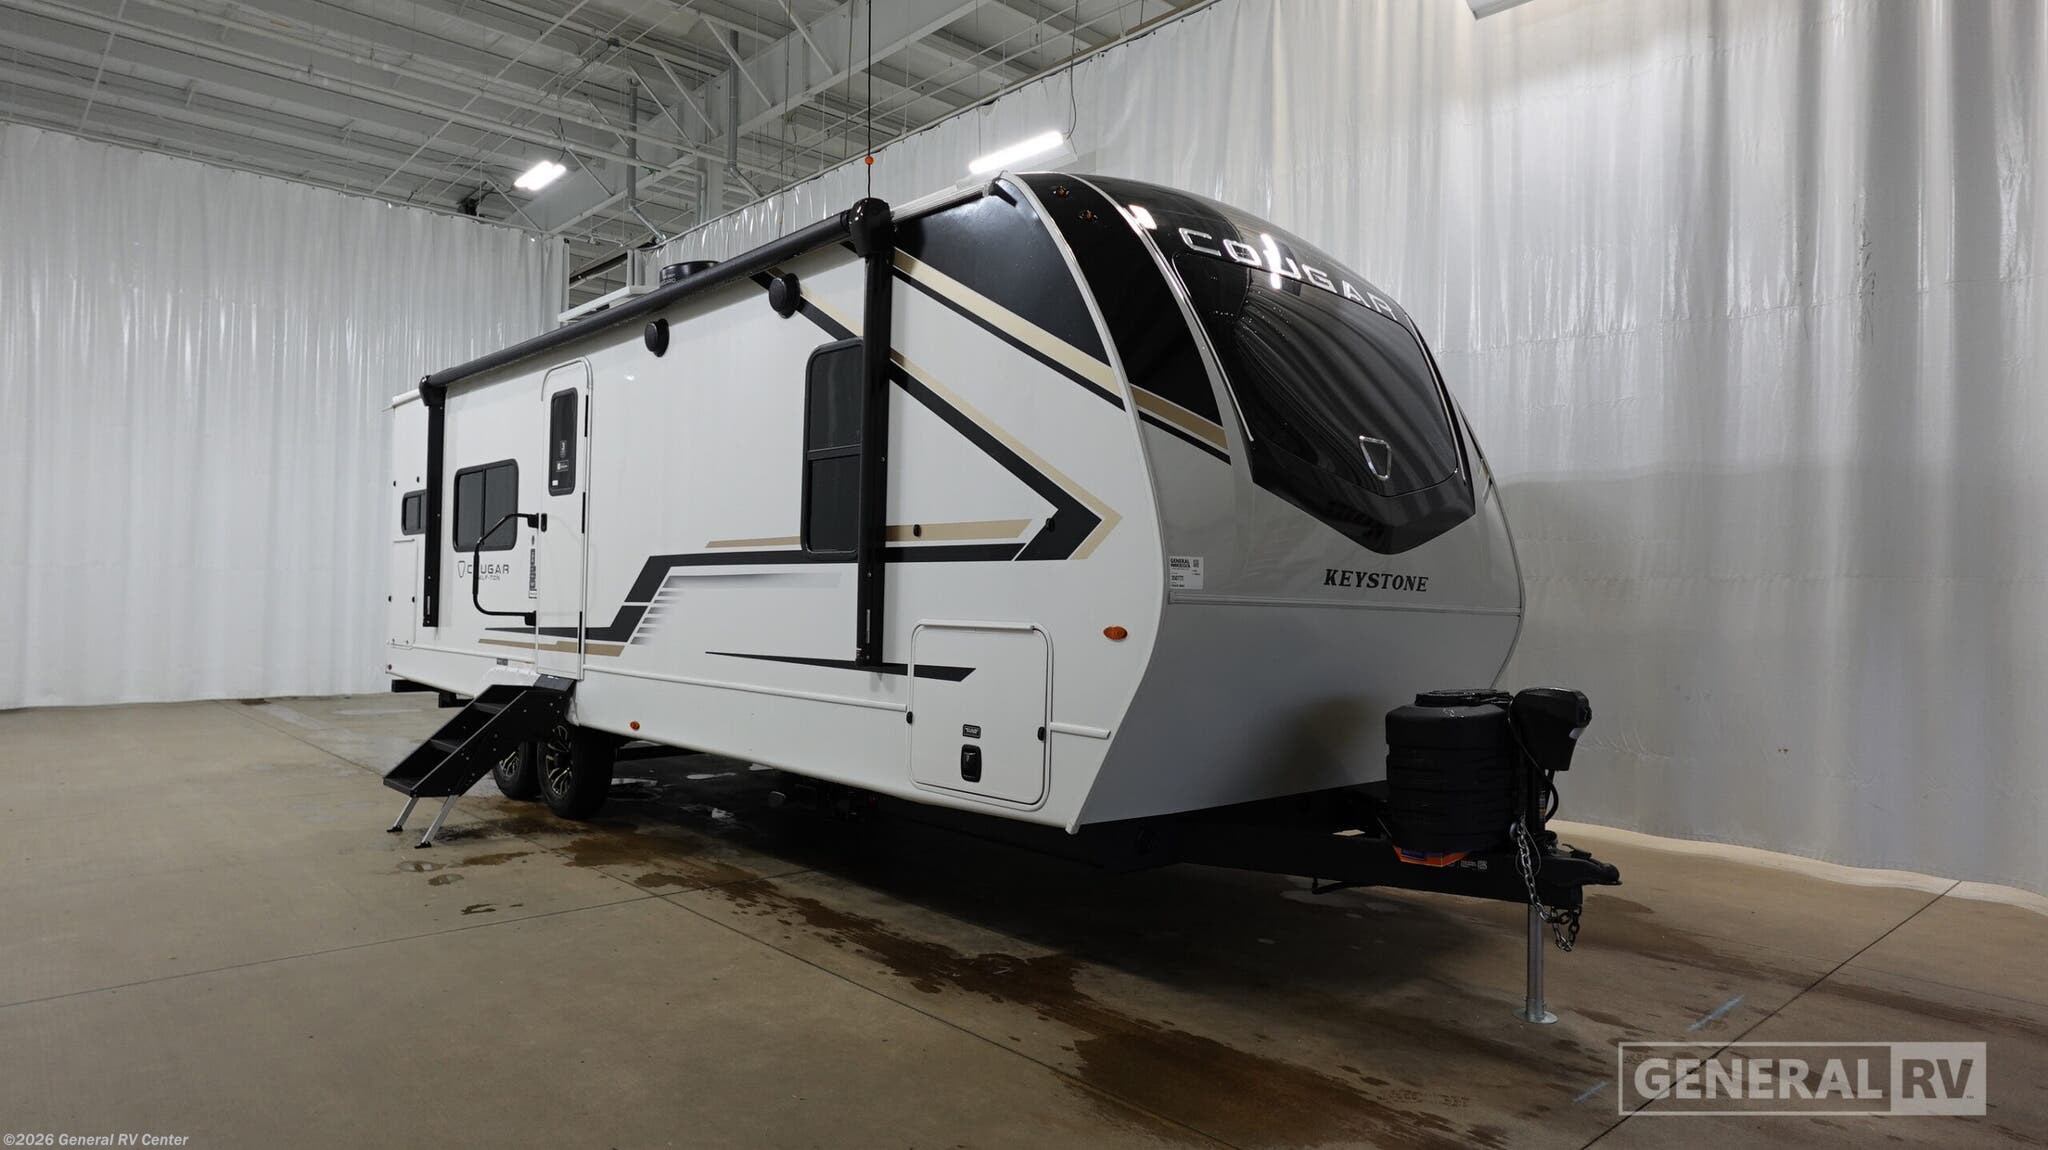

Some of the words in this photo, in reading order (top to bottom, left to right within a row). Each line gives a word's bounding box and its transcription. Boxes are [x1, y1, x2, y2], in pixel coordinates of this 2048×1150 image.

[1178, 227, 1398, 321] COUGAR
[467, 564, 510, 575] CUGAR
[1323, 568, 1429, 592] KEYSTONE
